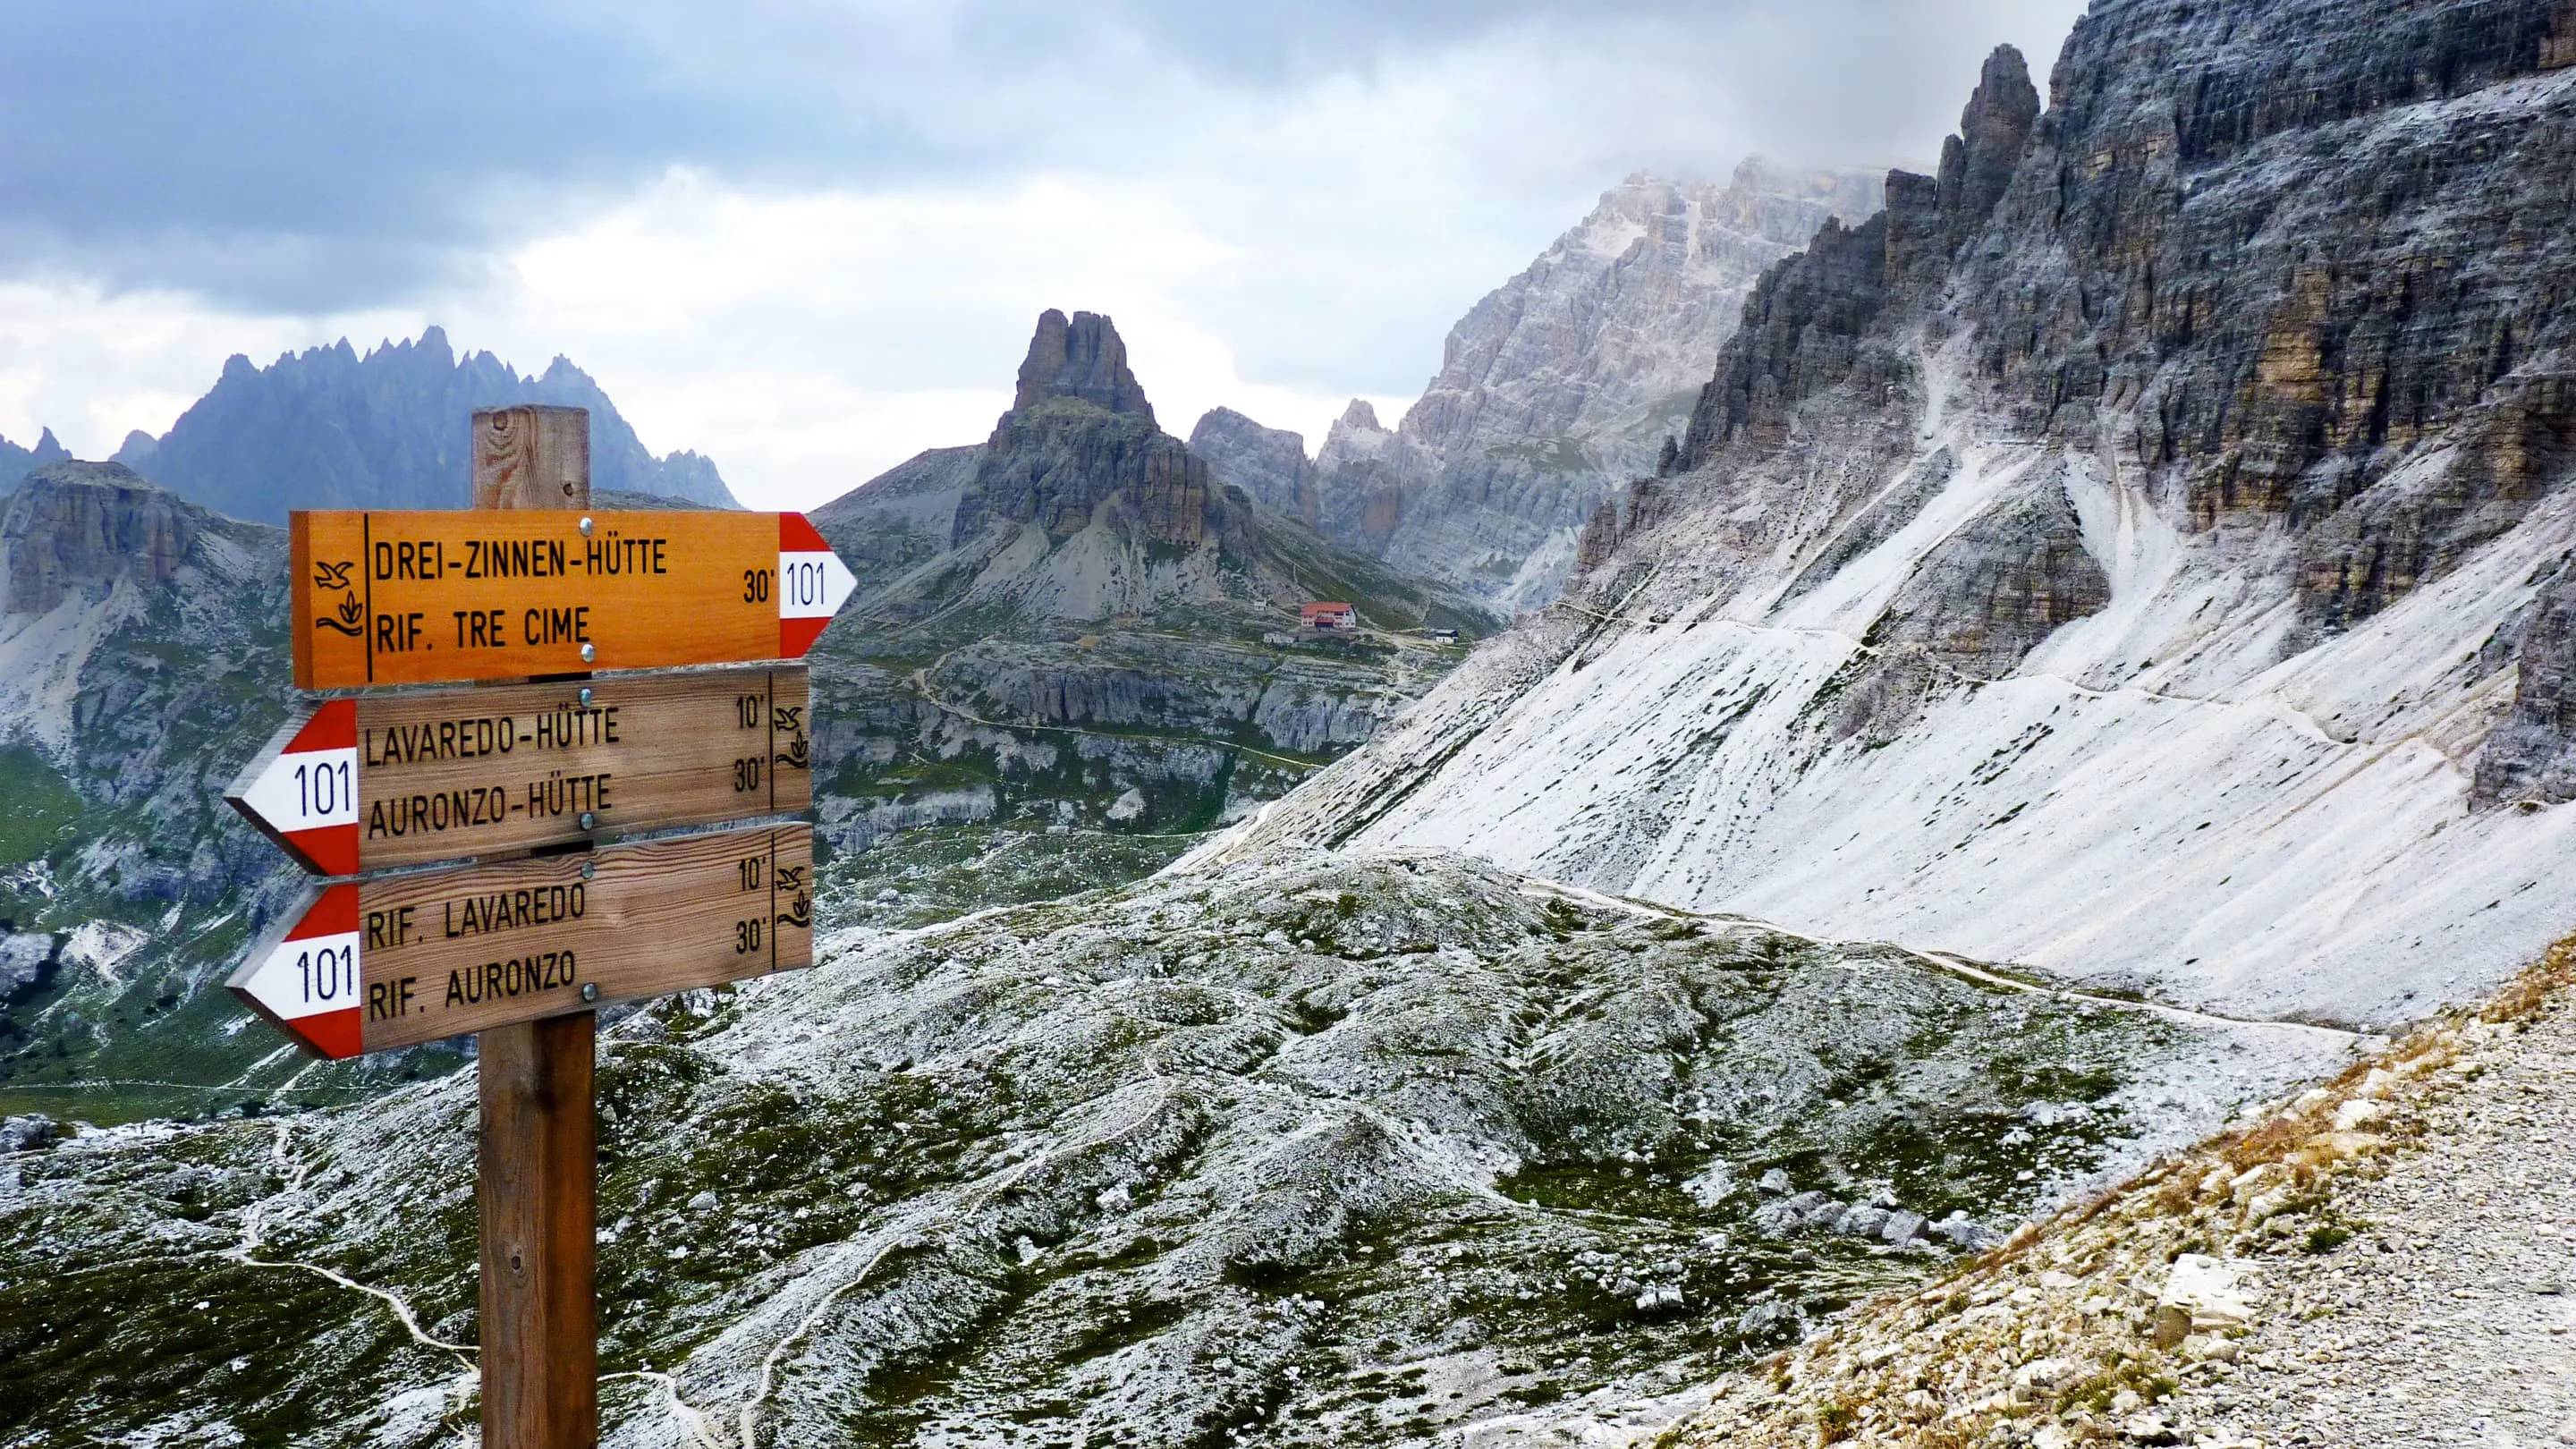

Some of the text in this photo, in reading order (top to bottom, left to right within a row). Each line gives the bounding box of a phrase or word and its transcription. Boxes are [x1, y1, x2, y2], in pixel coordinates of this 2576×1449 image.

[376, 531, 667, 580] DREI-ZINNEN-HÜTTE
[787, 562, 826, 606] 101
[377, 606, 589, 652] RIF. TRE CIME
[366, 703, 620, 767] LAVAREDO-HÜTTE
[294, 761, 350, 816] 101
[369, 770, 612, 839] AURONZO-HÜTTE
[369, 883, 585, 950] RIF. LAVAREDO
[297, 945, 352, 1003] 101
[369, 951, 575, 1021] RIF. AURONZO
